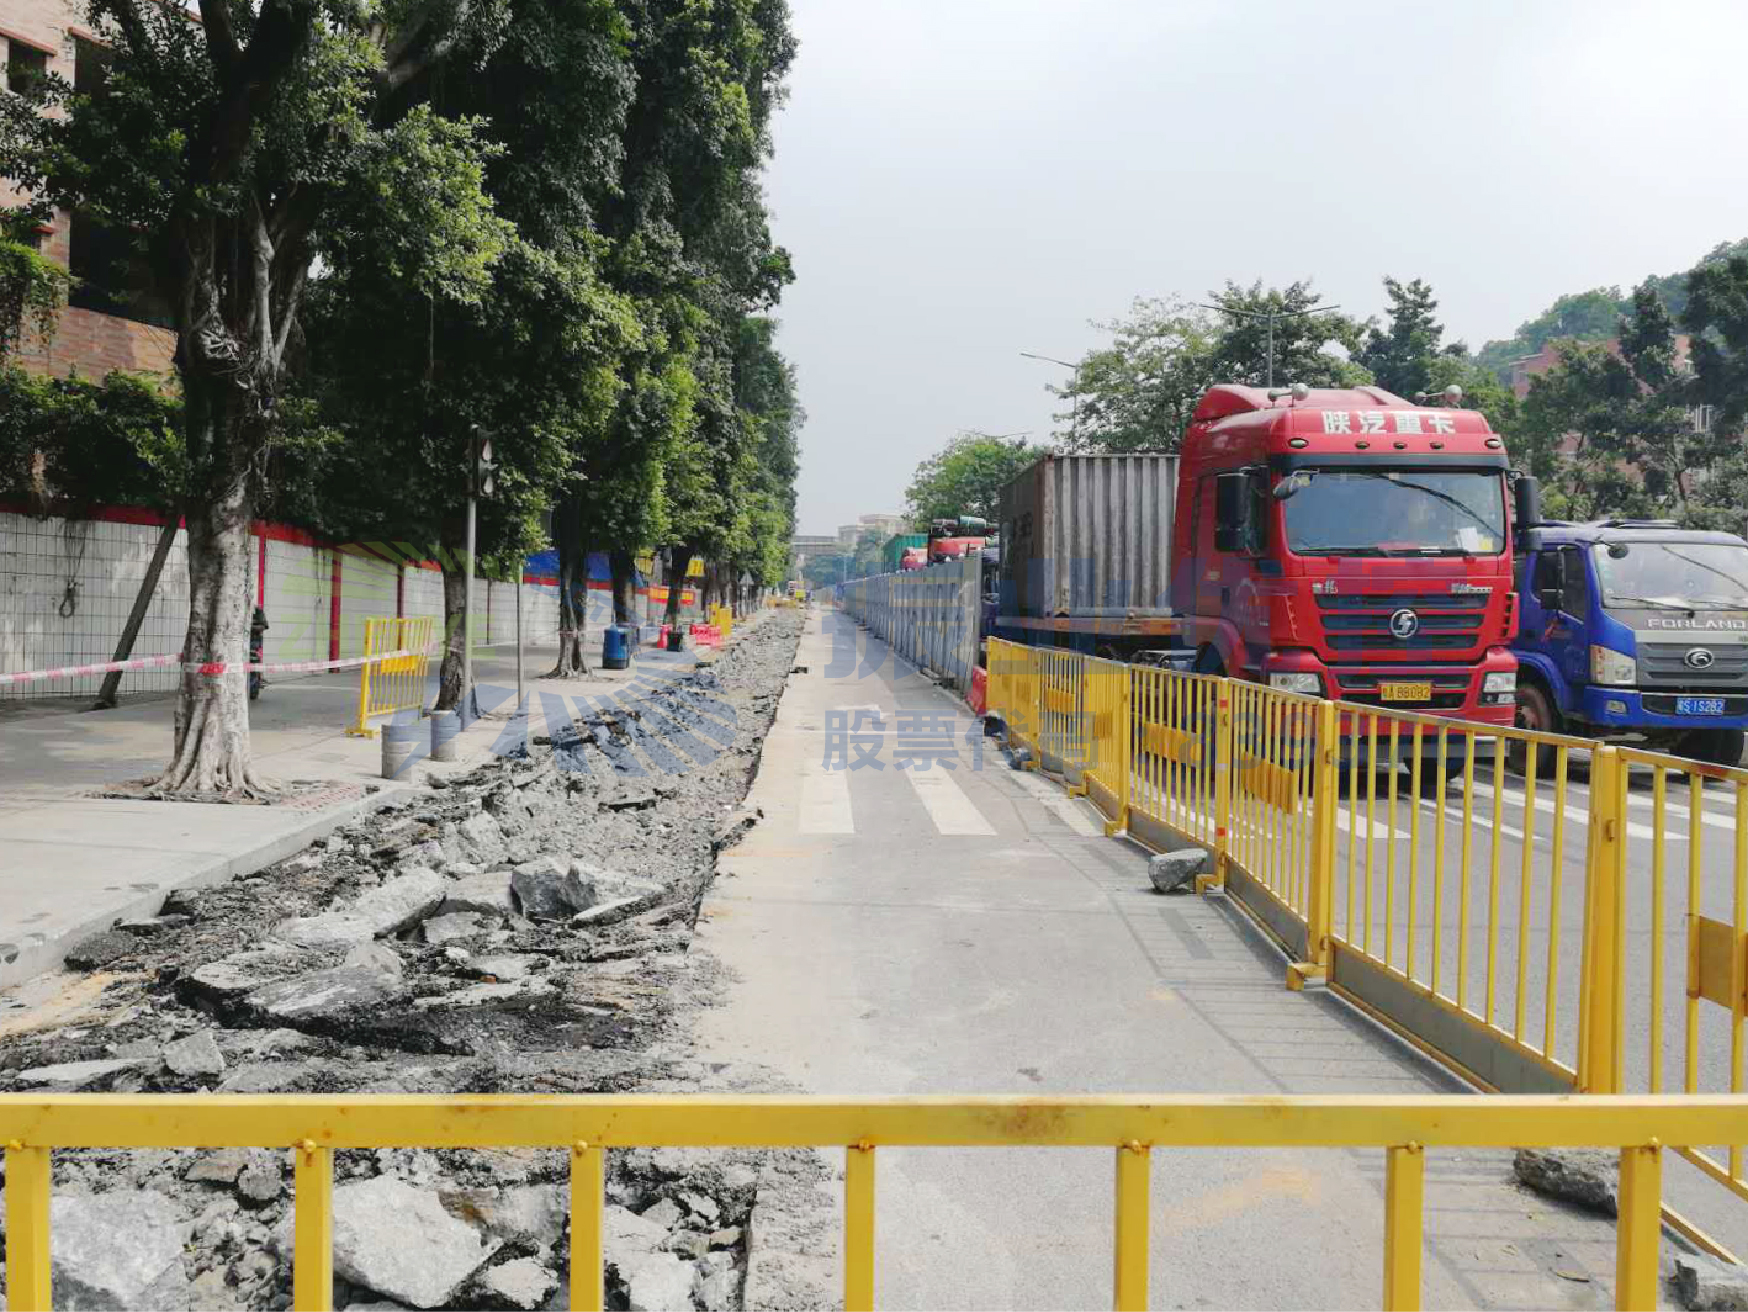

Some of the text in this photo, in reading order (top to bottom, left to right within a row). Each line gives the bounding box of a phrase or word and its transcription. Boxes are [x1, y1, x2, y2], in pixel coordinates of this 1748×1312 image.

[1321, 410, 1456, 434] 陕汽重卡
[1647, 618, 1745, 629] FORLAND
